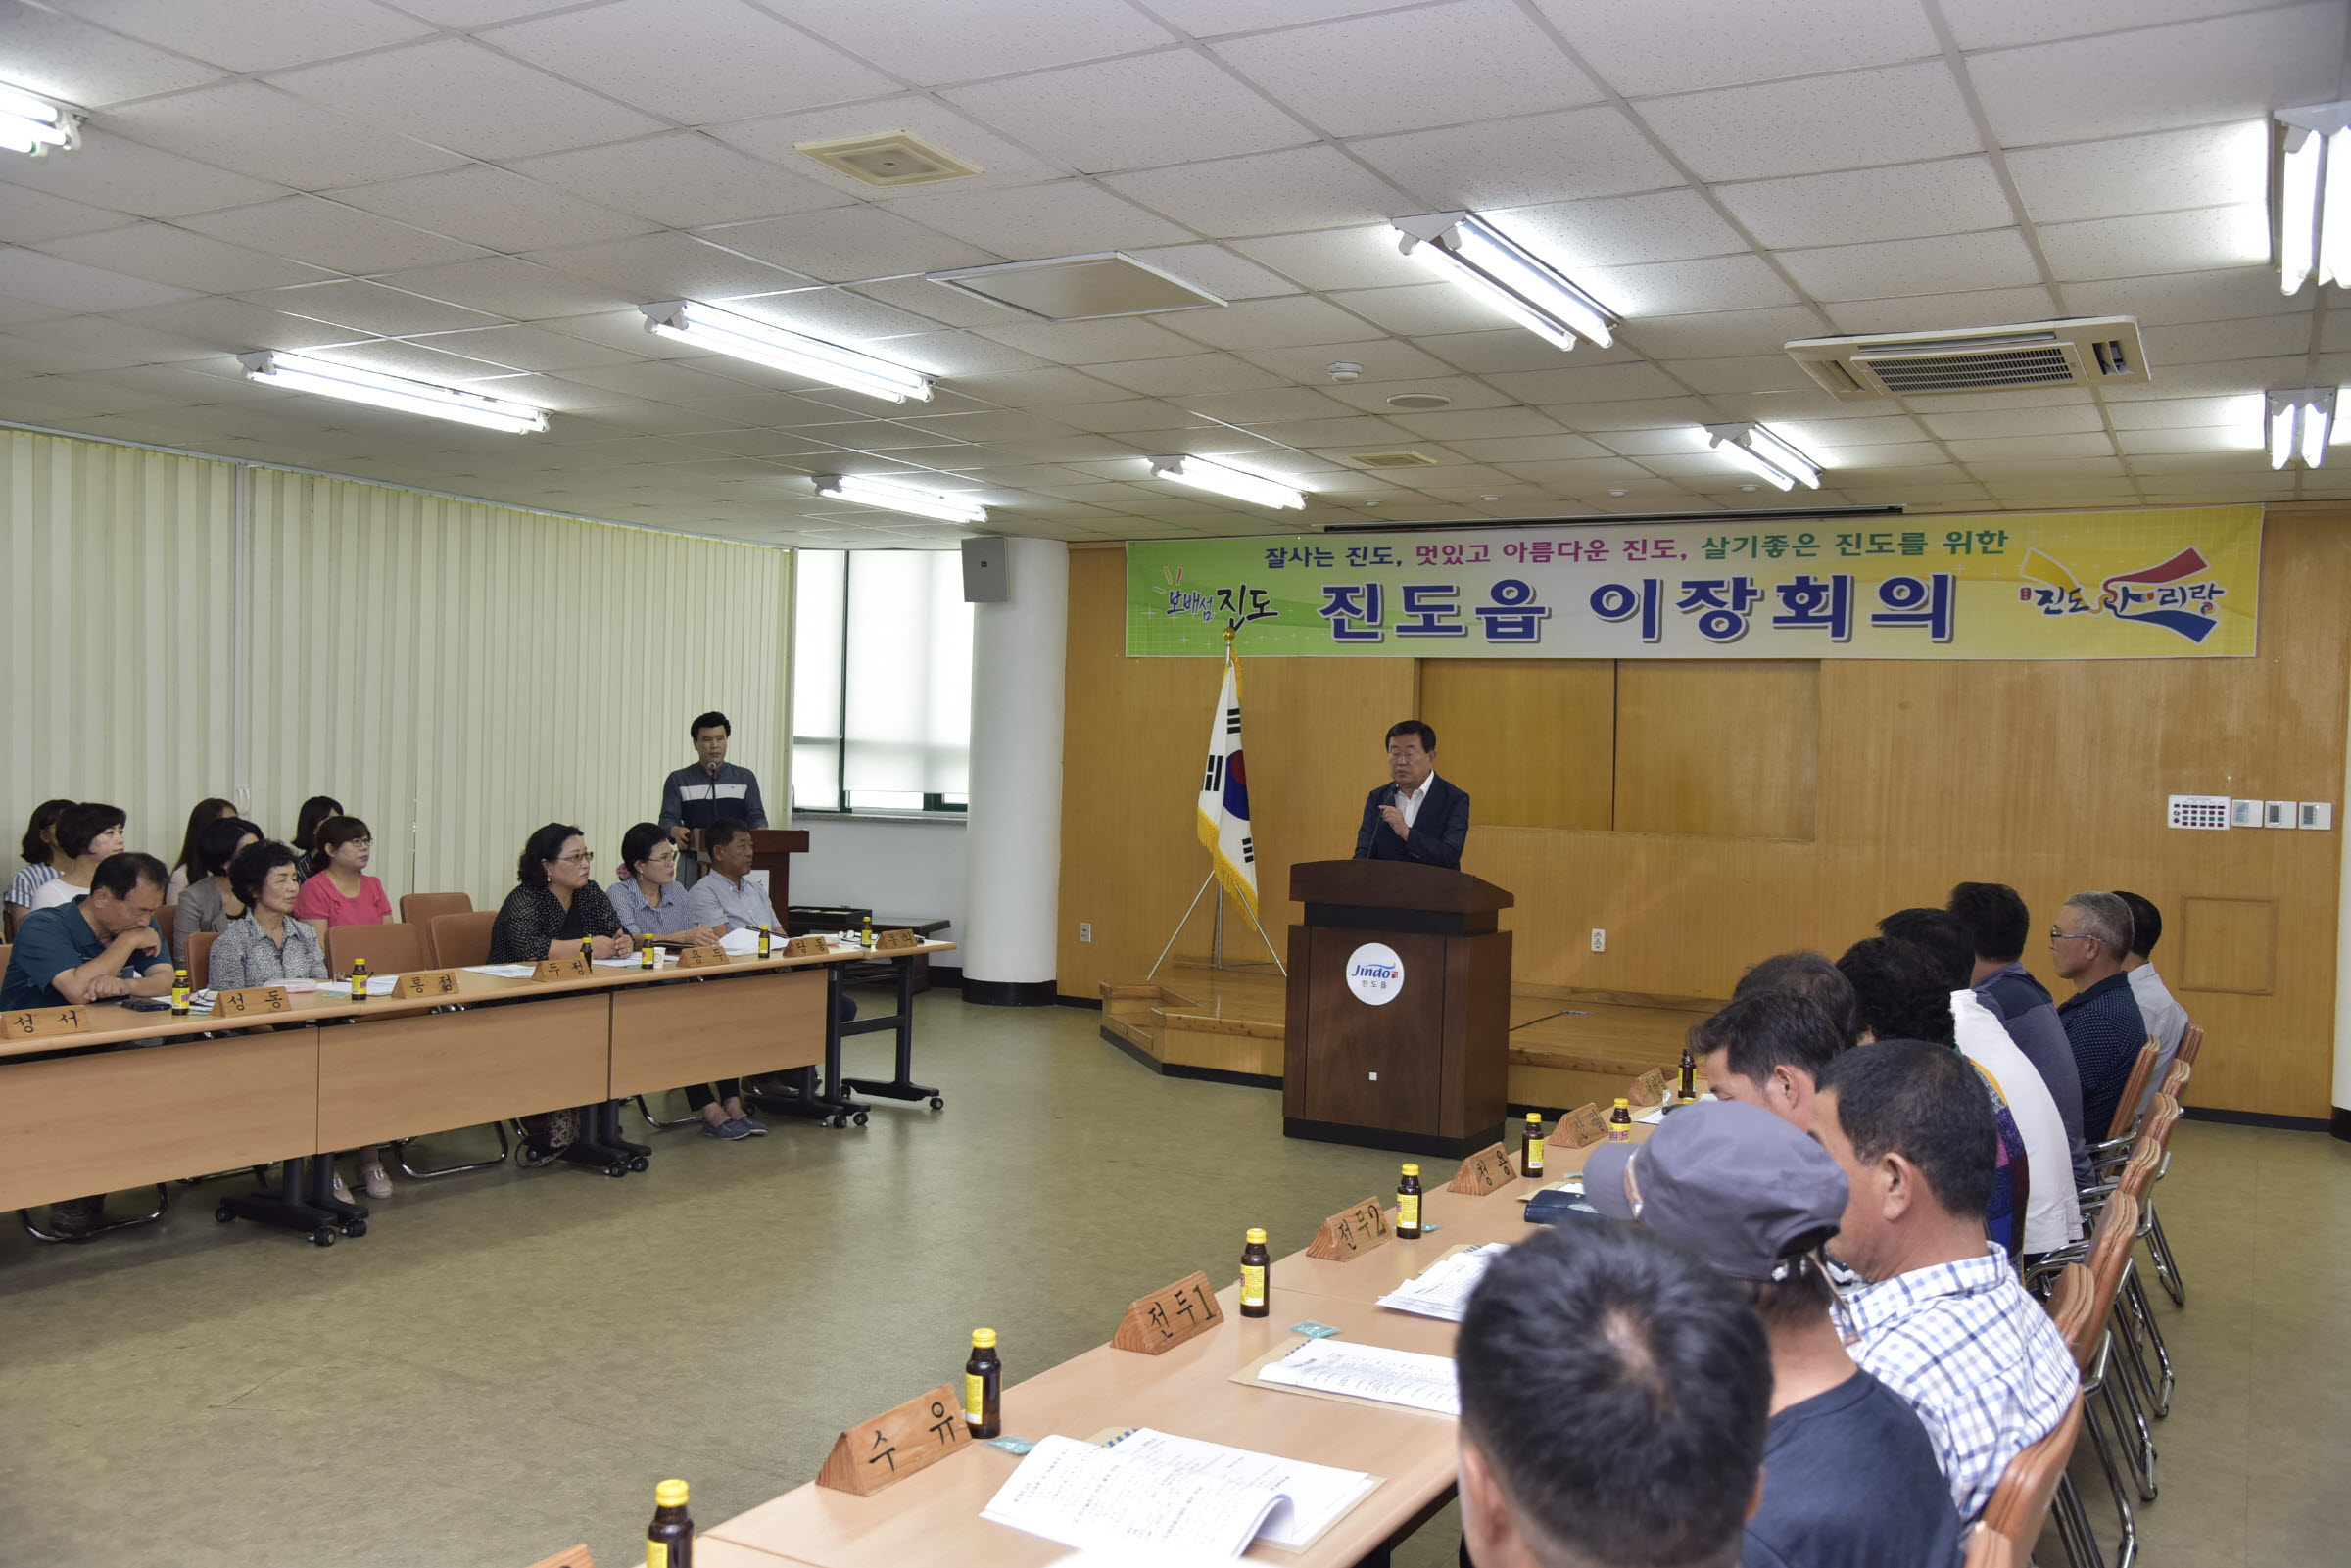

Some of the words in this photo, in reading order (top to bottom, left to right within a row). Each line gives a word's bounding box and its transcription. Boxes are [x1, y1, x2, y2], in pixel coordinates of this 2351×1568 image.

[1265, 546, 1335, 568] 잘사는
[1345, 546, 1403, 568] 진도,
[1415, 545, 1490, 566] 멋있고
[1503, 539, 1609, 564] 아름다운
[1622, 538, 1687, 562] 진도,
[1701, 532, 1822, 560] 살기좋은
[1835, 531, 1928, 556] 진도를
[1943, 530, 2009, 555] 위한
[1167, 590, 1214, 622] 보배섬
[1217, 584, 1279, 633] 진도
[1319, 579, 1548, 641] 진도읍
[1589, 573, 1953, 641] 이장회의
[1352, 964, 1391, 979] Jindo
